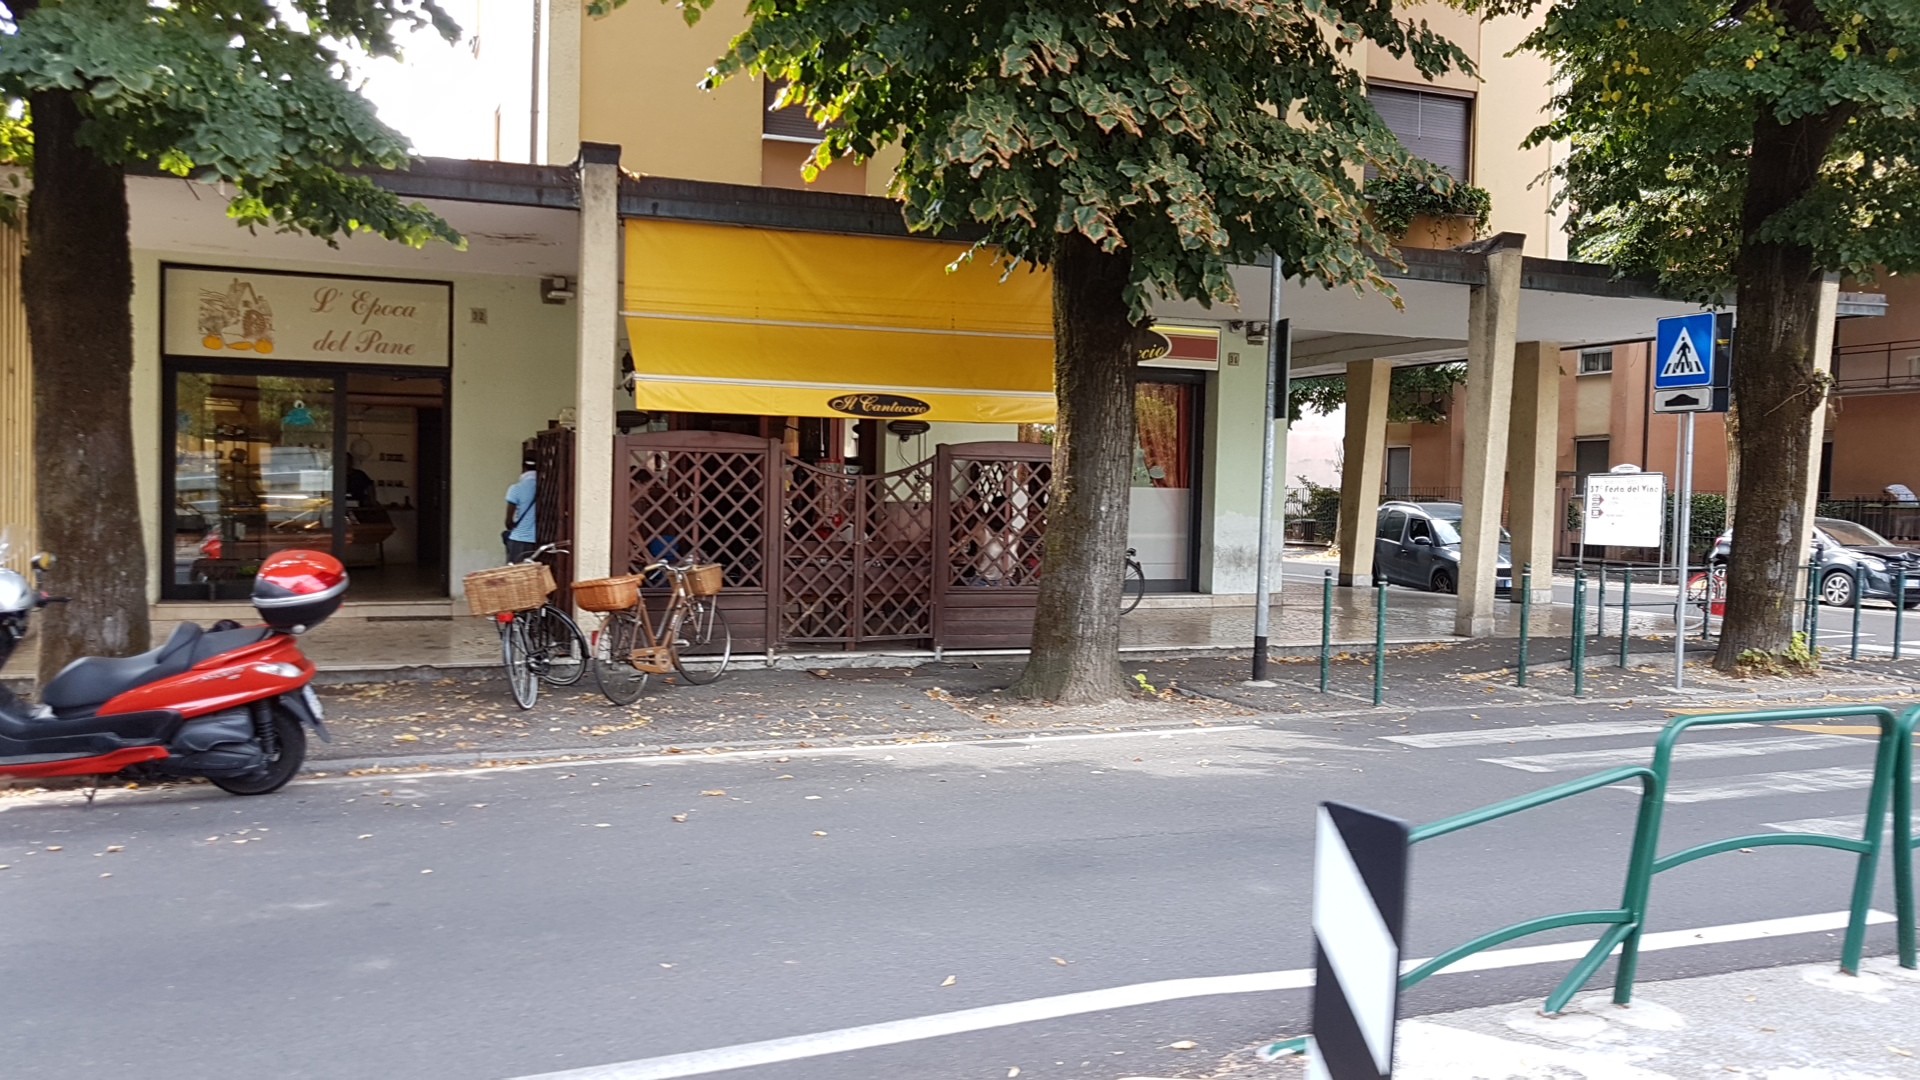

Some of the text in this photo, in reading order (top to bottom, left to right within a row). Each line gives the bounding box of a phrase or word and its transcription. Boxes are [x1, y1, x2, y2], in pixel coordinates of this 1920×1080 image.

[309, 286, 417, 325] L' Epoca
[312, 328, 416, 356] del Pane
[831, 394, 927, 414] Il Cantuccio
[1604, 485, 1625, 493] Festa
[1627, 485, 1640, 493] del
